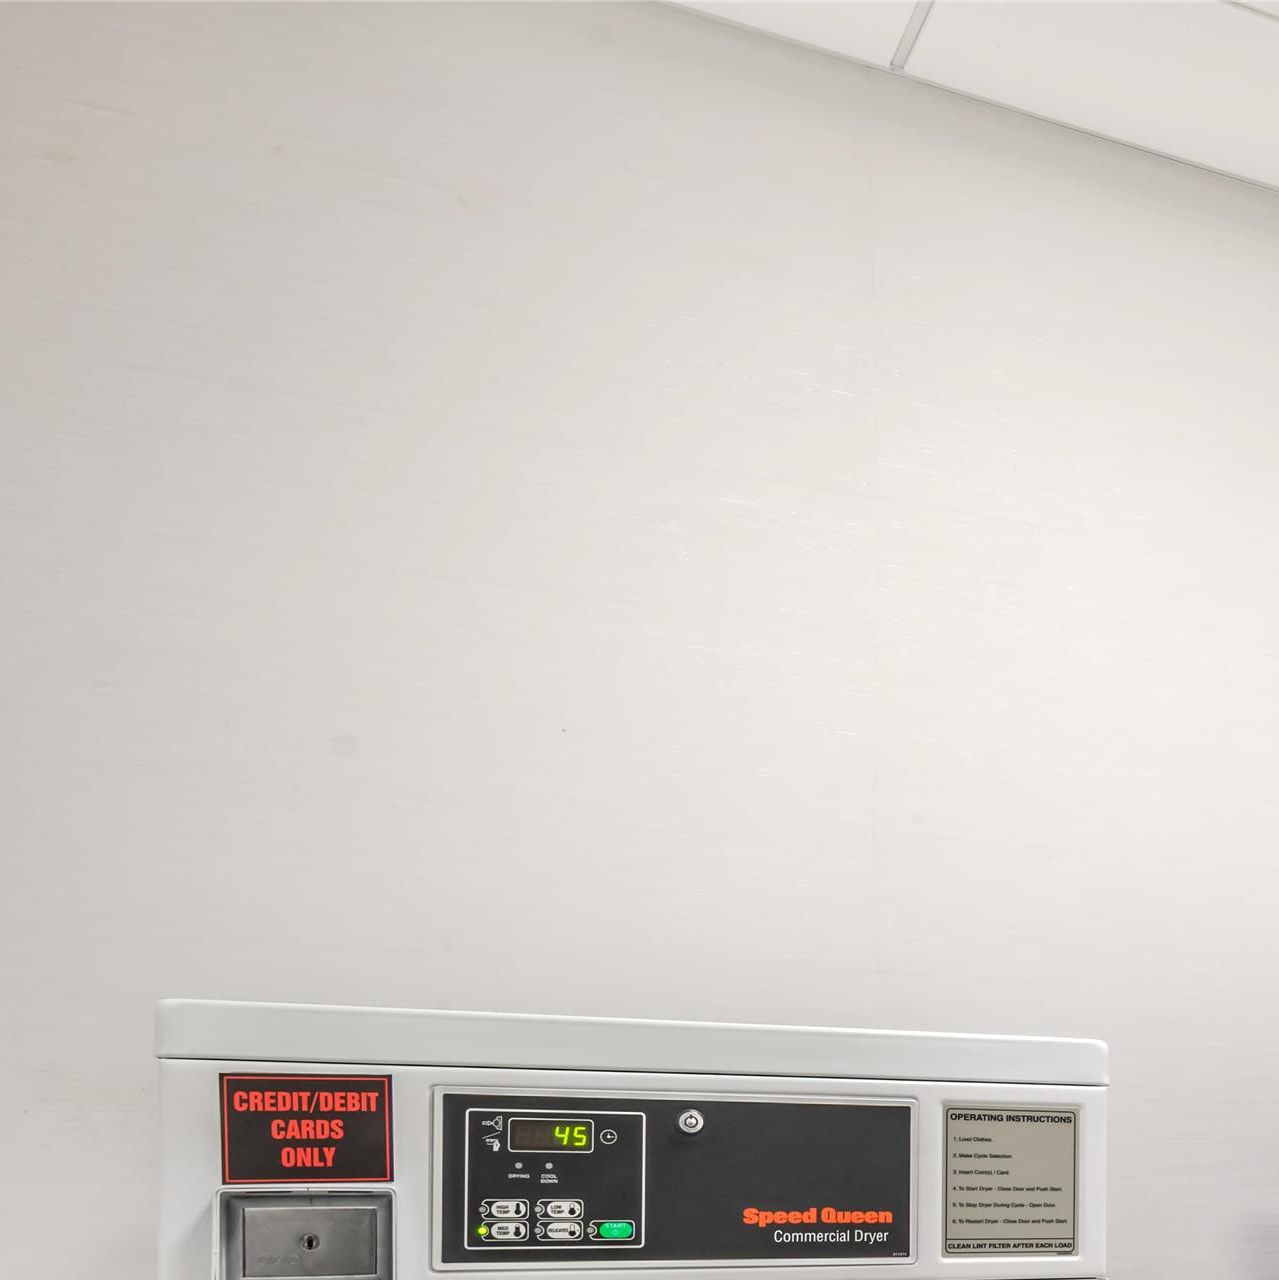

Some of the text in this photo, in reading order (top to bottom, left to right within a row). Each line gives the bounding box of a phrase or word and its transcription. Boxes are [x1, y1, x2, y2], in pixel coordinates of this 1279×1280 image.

[233, 1091, 379, 1112] CREDIT/DEBIT
[950, 1113, 1072, 1123] OPERATING INSTRUCTIONS
[271, 1119, 344, 1140] CARDS
[554, 1126, 586, 1146] 45
[281, 1147, 336, 1167] ONLY
[743, 1206, 892, 1228] Speed Queen
[774, 1229, 889, 1245] Commercial Dryer
